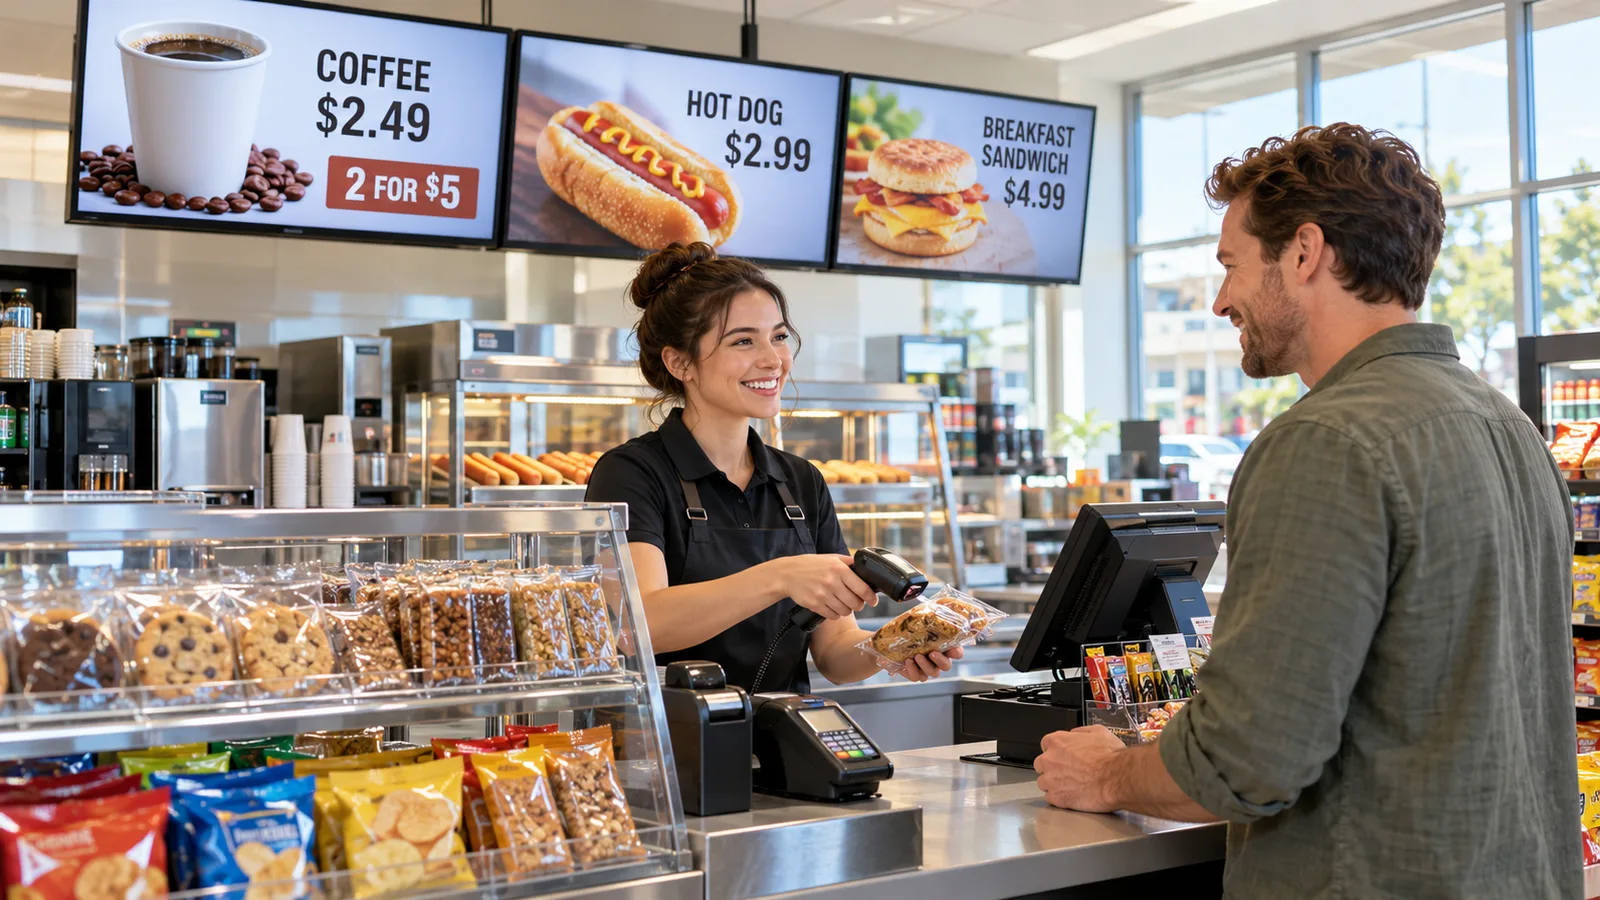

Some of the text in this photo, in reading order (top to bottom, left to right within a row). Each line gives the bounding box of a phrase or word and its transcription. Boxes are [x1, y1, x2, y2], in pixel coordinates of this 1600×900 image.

[316, 48, 432, 93] COFFEE
[316, 91, 430, 143] $2.49
[687, 89, 783, 126] HOT DOG
[724, 129, 811, 173] $2.99
[983, 116, 1076, 149] BREAKFAST
[981, 143, 1069, 175] SANDWICH
[345, 166, 460, 209] 2 FOR $5
[1003, 176, 1066, 211] $4.99
